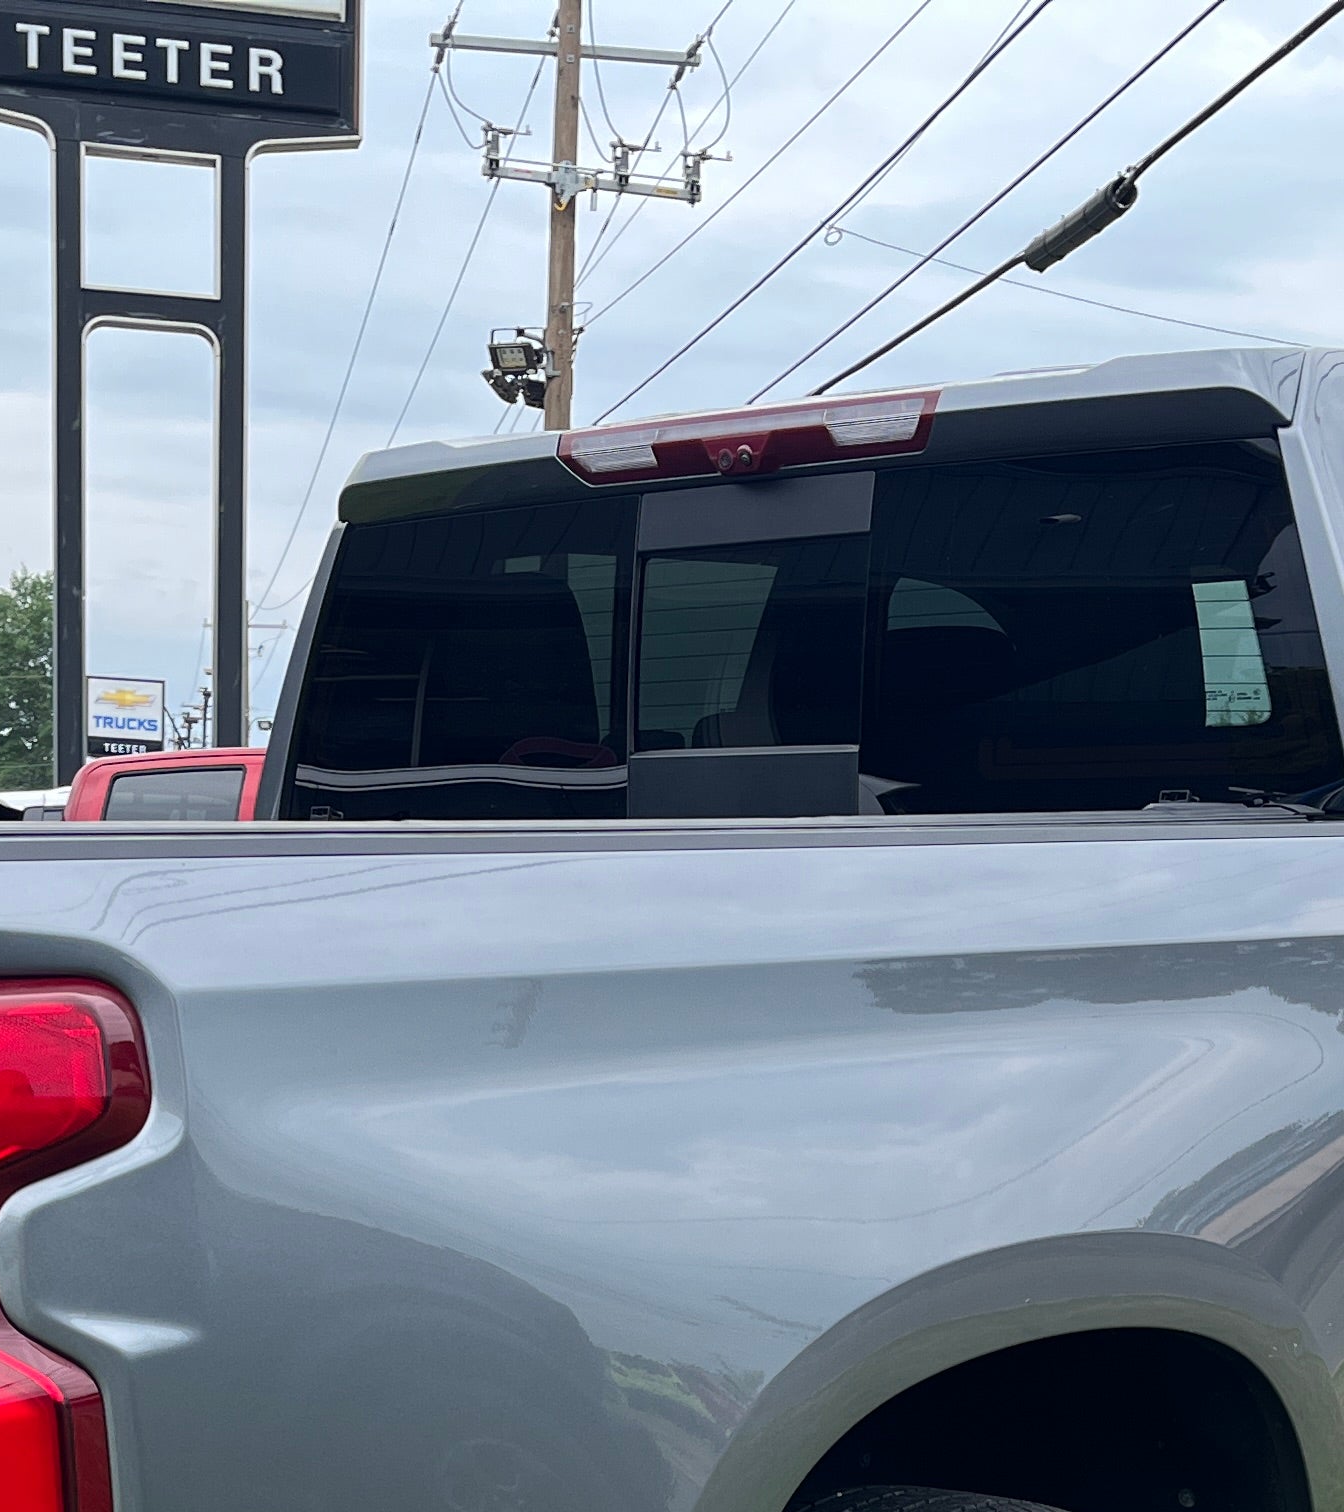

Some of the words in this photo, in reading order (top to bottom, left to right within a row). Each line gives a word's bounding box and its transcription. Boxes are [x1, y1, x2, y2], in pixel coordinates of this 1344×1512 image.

[14, 21, 285, 96] TEETER
[94, 716, 157, 731] TRUCKS
[103, 742, 146, 754] TEETER
